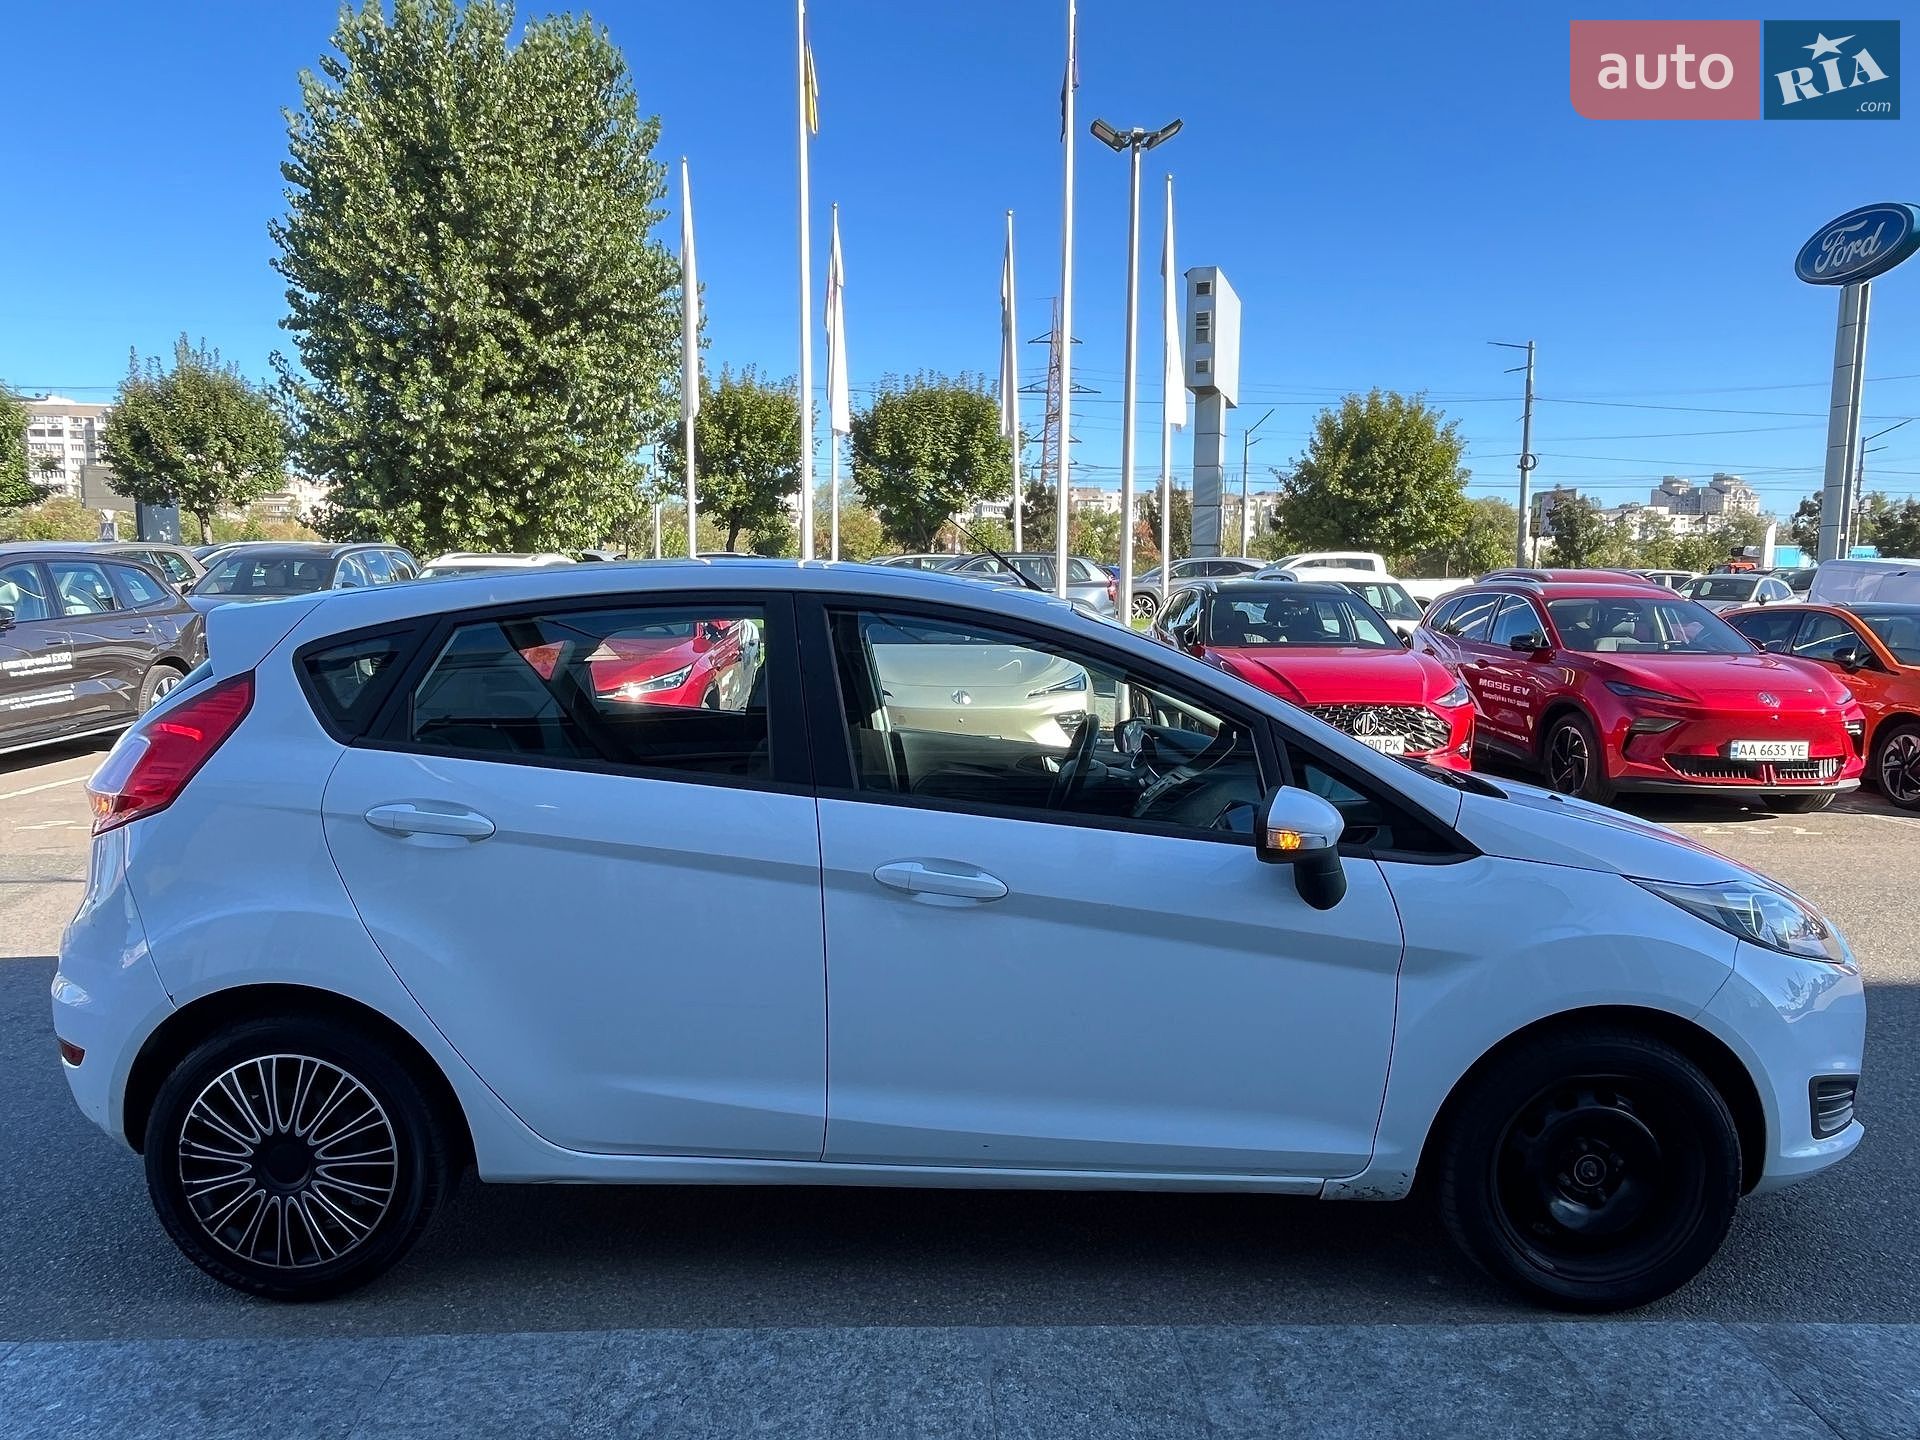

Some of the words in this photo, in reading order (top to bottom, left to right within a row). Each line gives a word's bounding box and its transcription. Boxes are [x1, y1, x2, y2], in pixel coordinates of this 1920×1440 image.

[1814, 219, 1886, 273] Ford
[1513, 685, 1530, 696] EV
[1355, 712, 1377, 735] MG
[1384, 738, 1400, 751] PK
[1739, 744, 1757, 756] AA
[1760, 744, 1787, 756] 6635
[1790, 744, 1806, 756] YE
